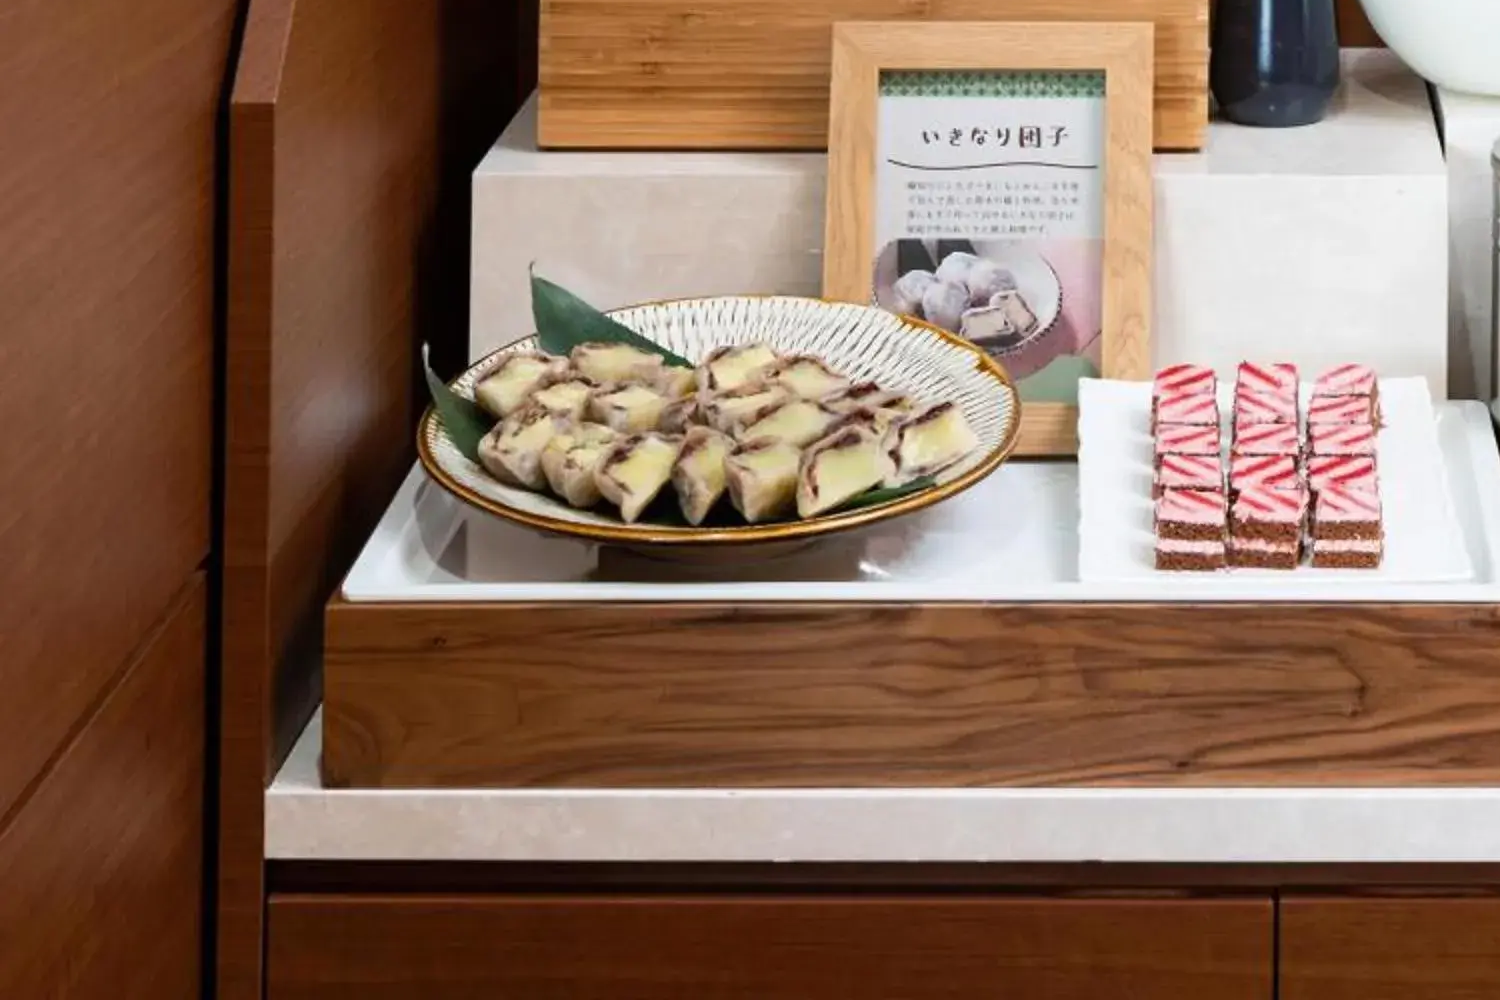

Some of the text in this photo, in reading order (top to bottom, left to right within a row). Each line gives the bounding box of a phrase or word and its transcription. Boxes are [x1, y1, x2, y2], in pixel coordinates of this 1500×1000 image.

[922, 126, 1069, 148] いきなり団子
